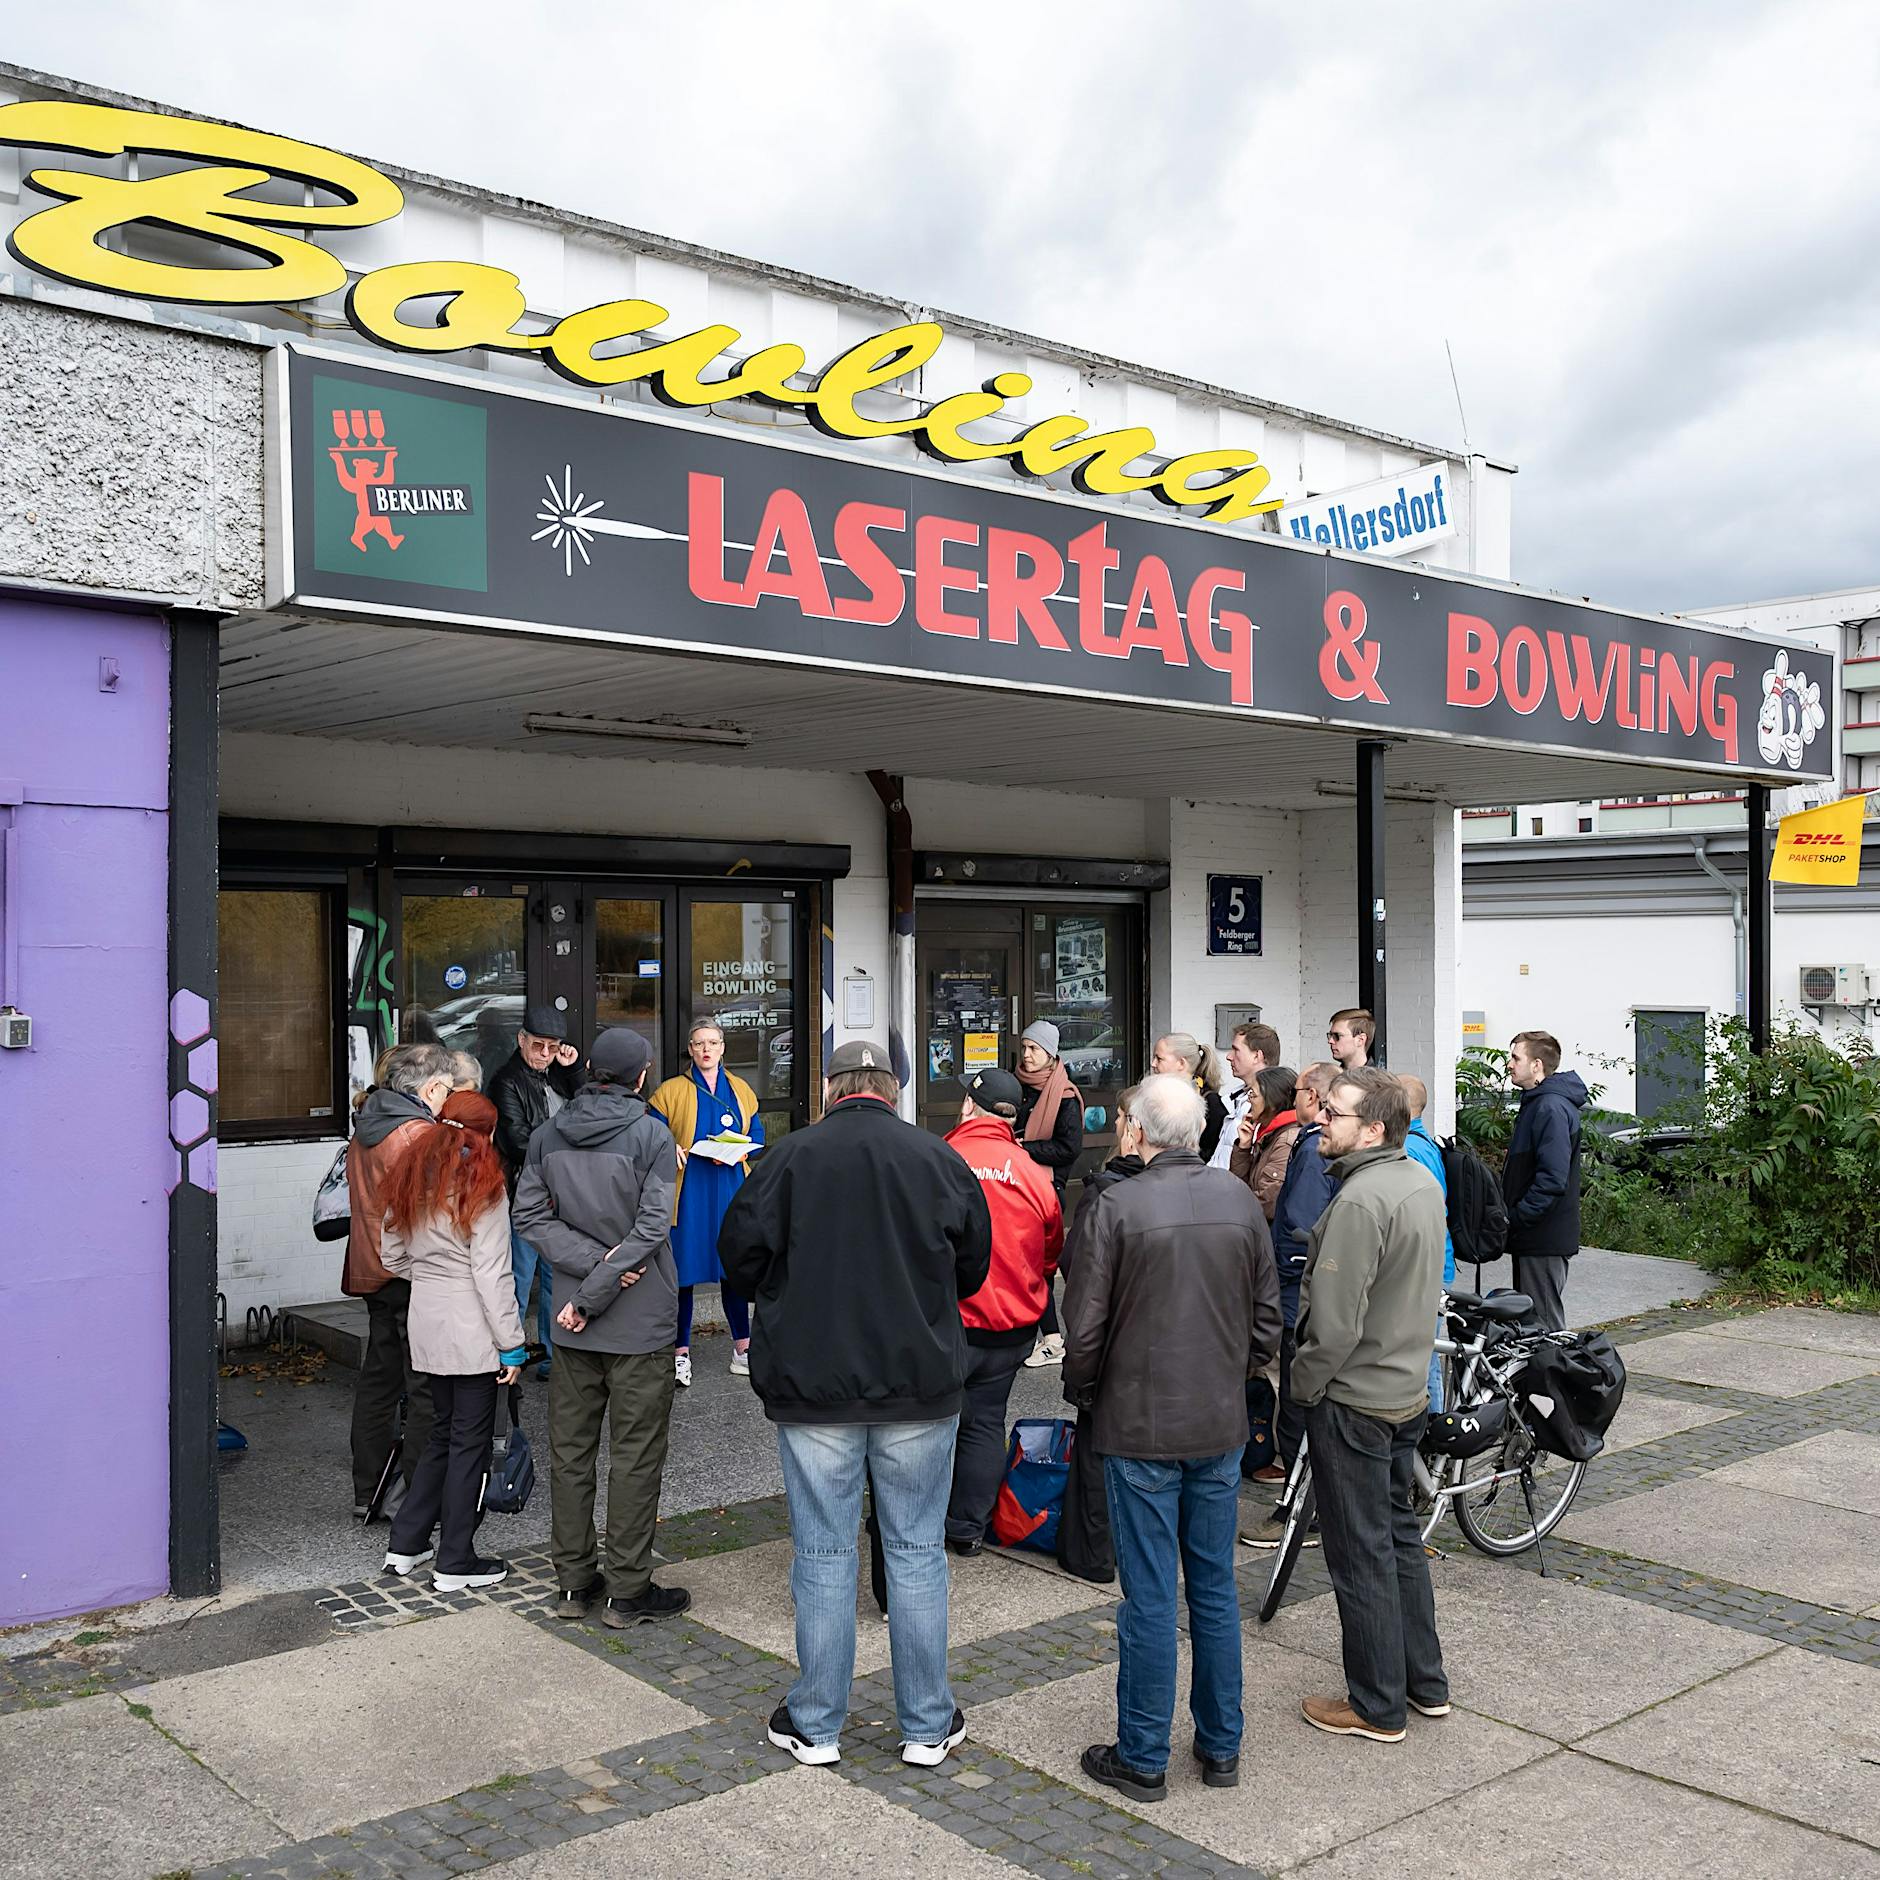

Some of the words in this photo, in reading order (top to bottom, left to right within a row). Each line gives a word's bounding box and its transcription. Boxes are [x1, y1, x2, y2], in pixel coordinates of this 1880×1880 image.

[0, 100, 1286, 523] Bowling
[375, 487, 468, 515] BERLINER
[1289, 474, 1447, 551] Hellersdorf
[1318, 590, 1390, 705] &
[1793, 833, 1845, 845] DHL
[1789, 853, 1846, 863] PAKETSHOP
[1228, 887, 1245, 923] 5
[1219, 929, 1256, 941] Feldberger
[1227, 941, 1243, 953] Ring
[703, 960, 776, 976] EINGANG
[703, 980, 777, 995] BOWLING
[714, 1012, 778, 1027] ASERTAG
